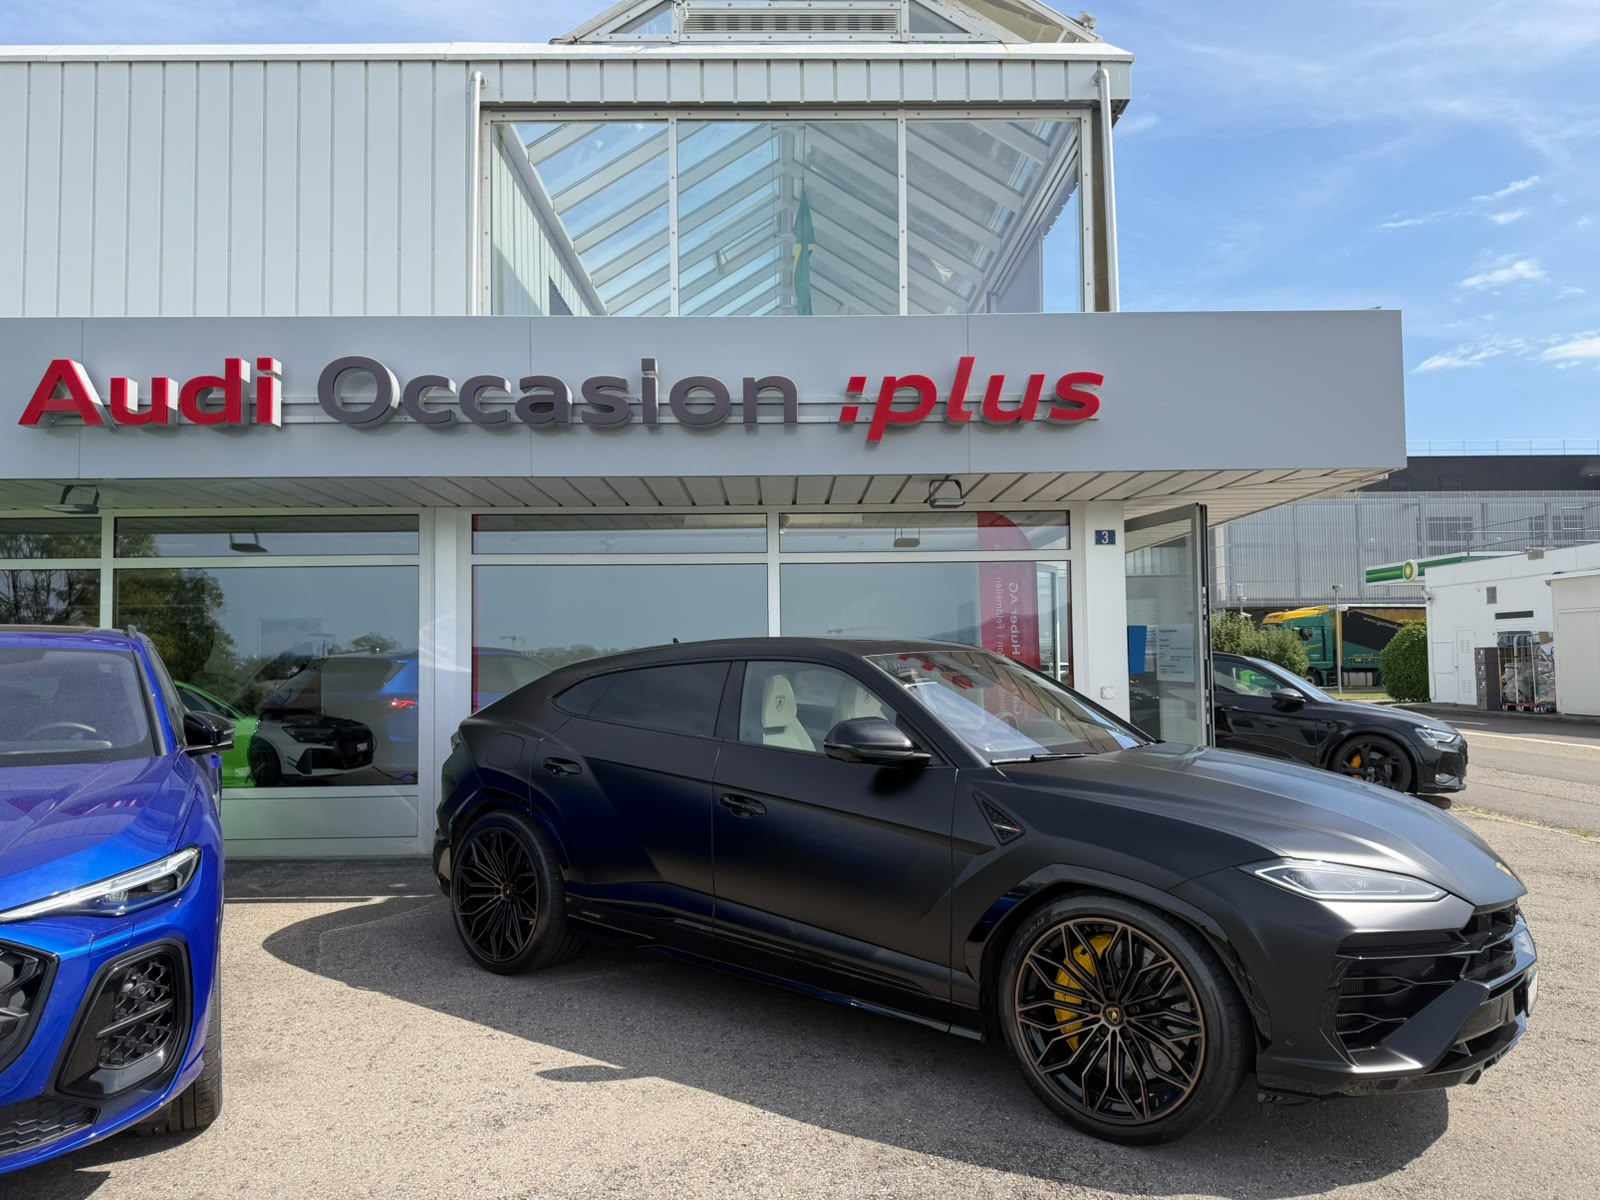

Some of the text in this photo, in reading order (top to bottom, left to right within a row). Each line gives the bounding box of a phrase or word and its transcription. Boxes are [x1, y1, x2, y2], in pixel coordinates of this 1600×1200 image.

[18, 357, 282, 428] Audi
[317, 356, 798, 428] Occasion
[1101, 530, 1109, 544] 3
